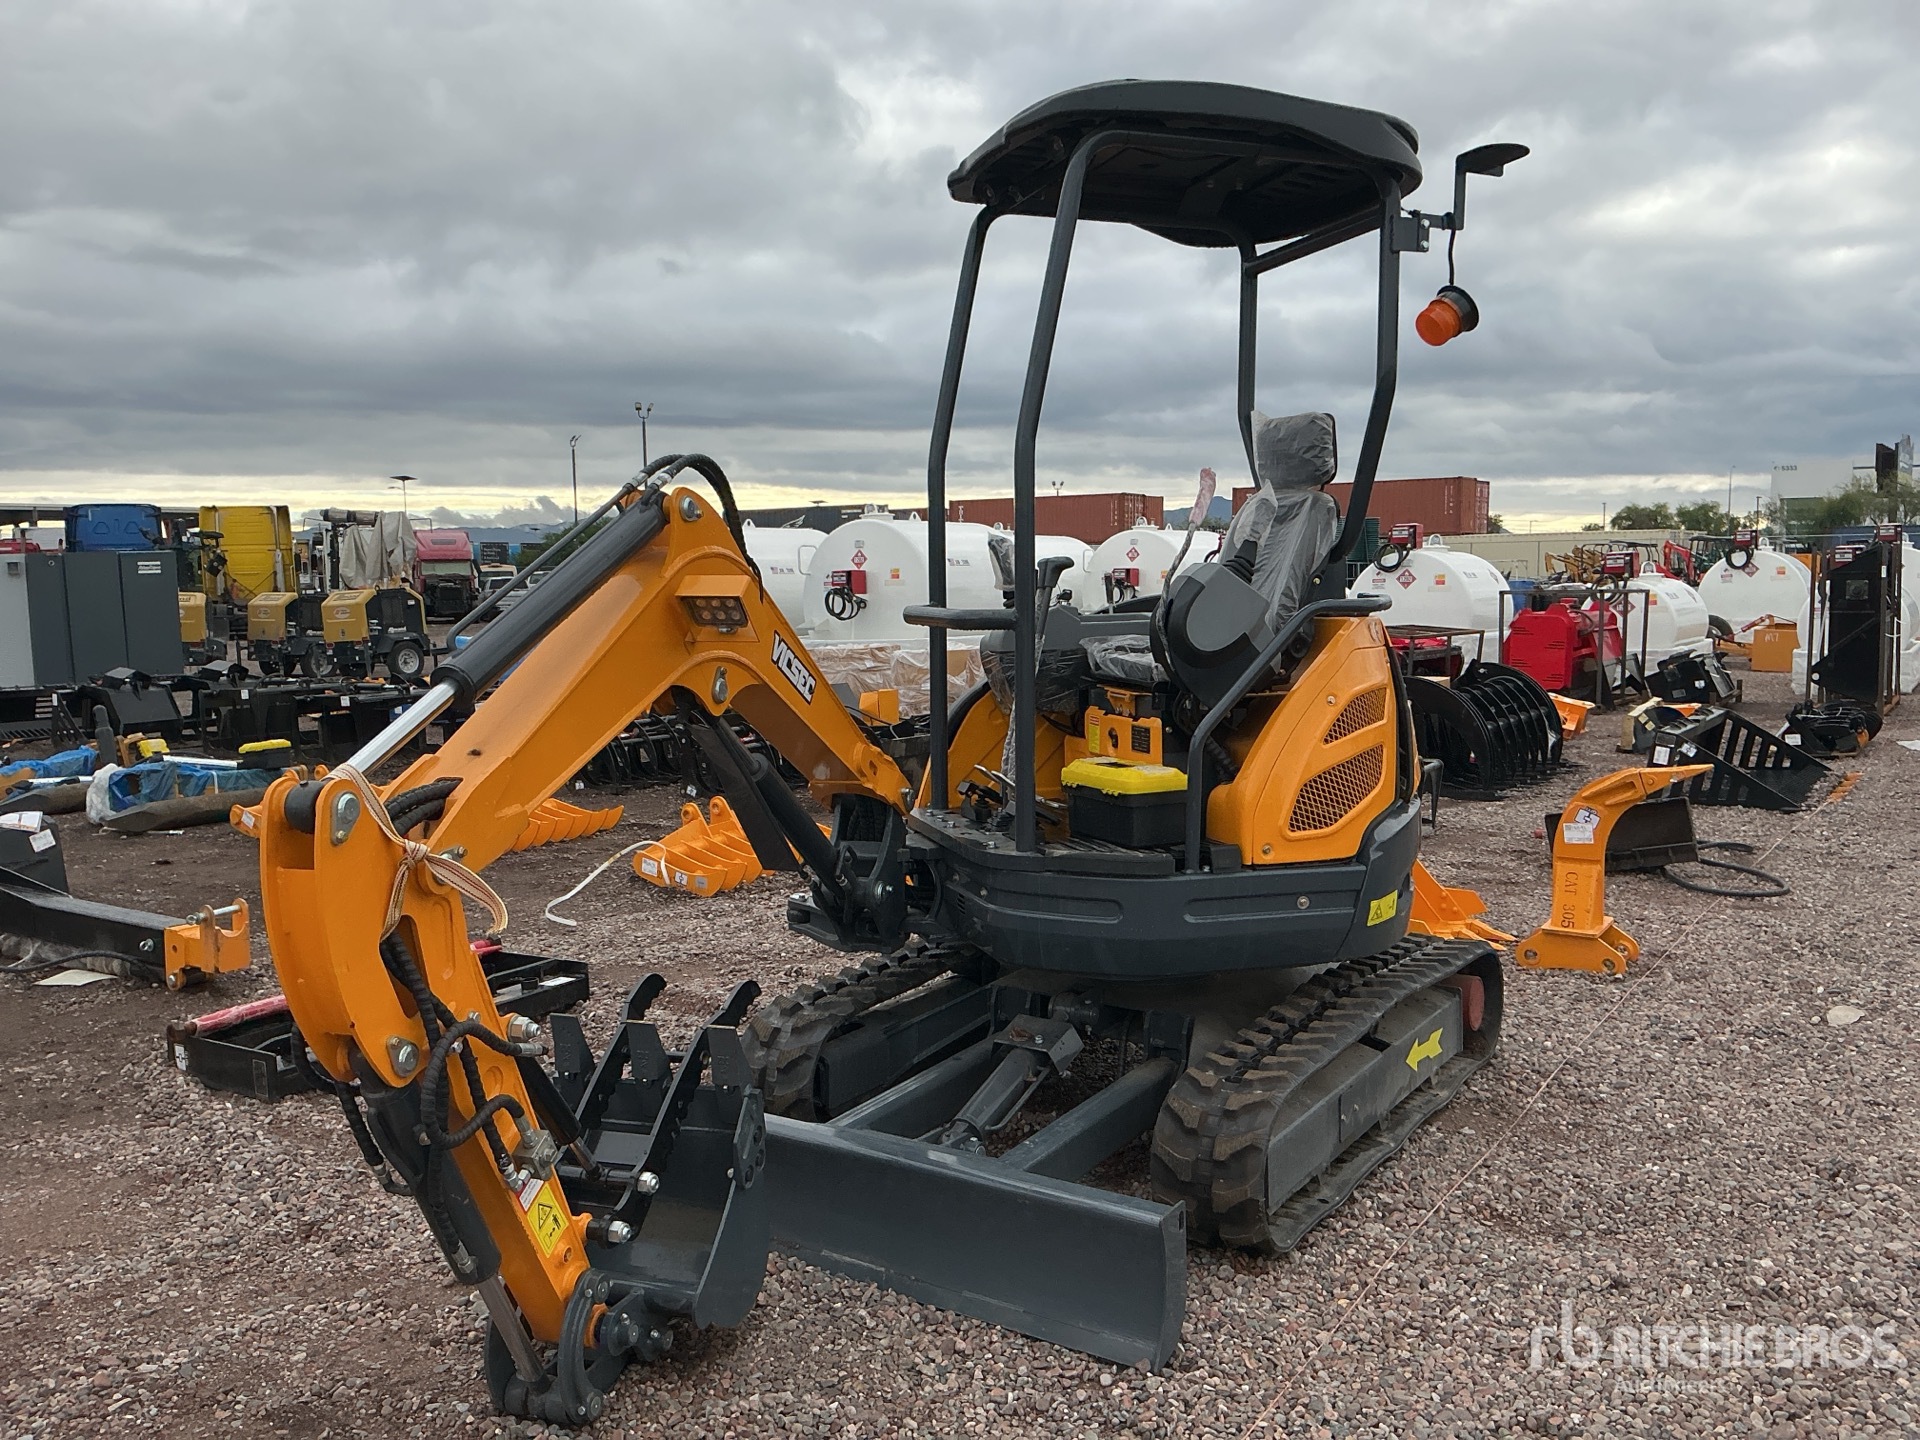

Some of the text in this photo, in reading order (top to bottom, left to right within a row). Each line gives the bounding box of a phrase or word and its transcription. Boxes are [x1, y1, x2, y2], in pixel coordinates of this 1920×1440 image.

[771, 632, 817, 703] VICSEC
[1561, 871, 1578, 928] CAT 305
